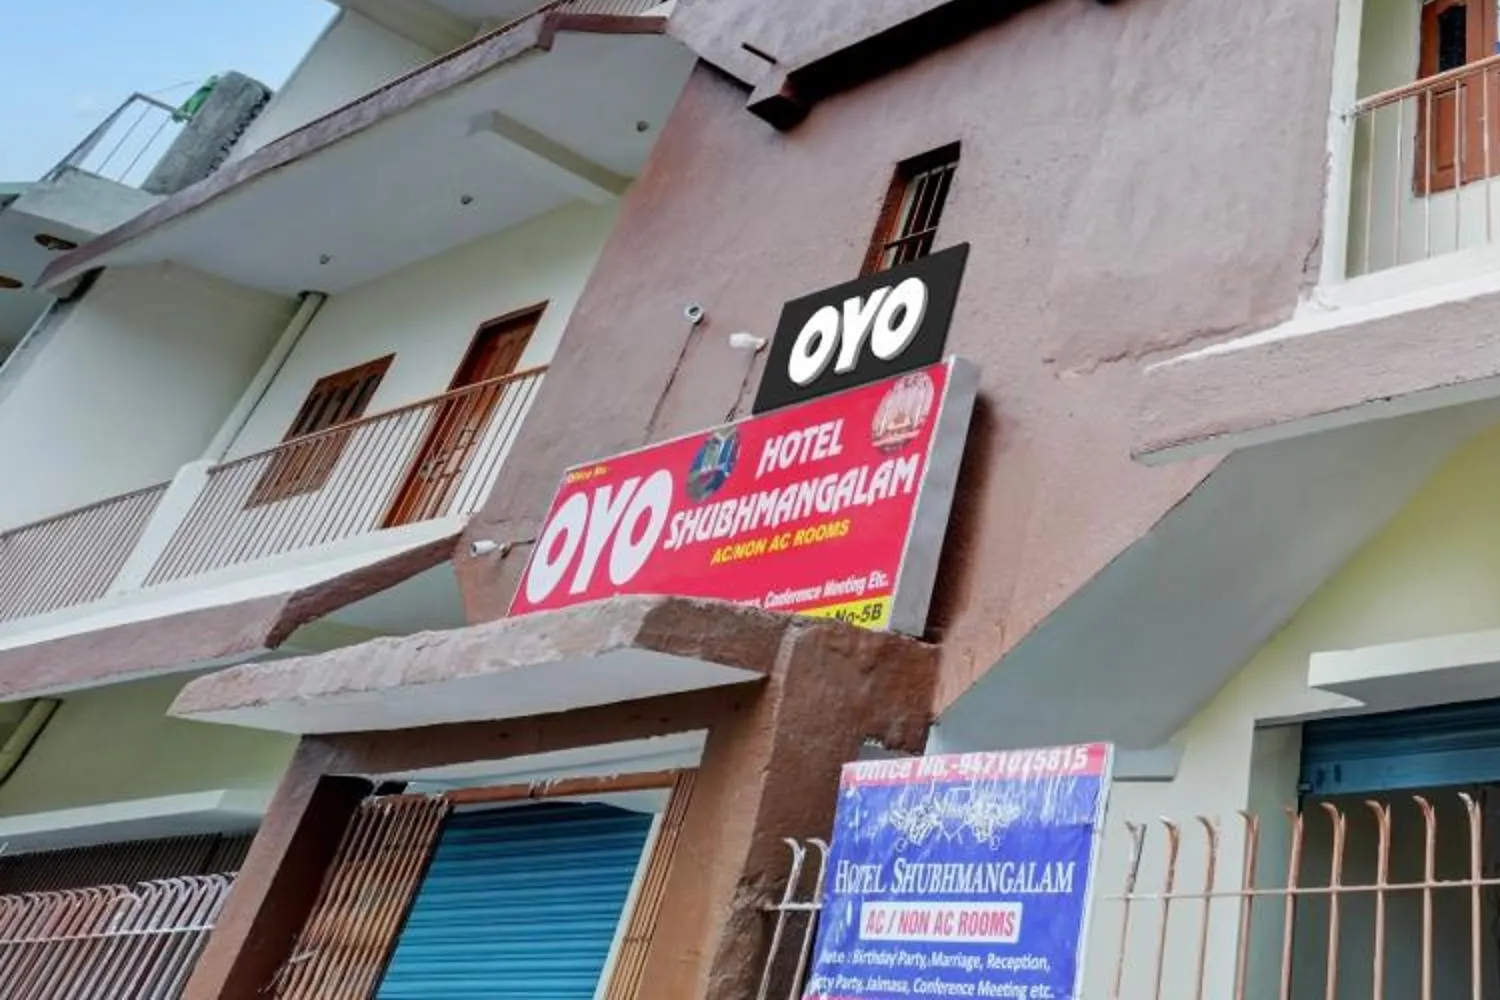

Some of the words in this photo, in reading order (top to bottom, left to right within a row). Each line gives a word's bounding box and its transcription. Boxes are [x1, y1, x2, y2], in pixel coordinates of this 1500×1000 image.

[788, 277, 928, 386] OYO
[755, 418, 844, 479] HOTEL
[663, 453, 921, 551] SHUBHMANGALAM
[526, 469, 673, 604] OYO
[768, 532, 792, 553] AC
[792, 518, 852, 546] ROOMS
[764, 585, 822, 608] Conference
[823, 576, 866, 597] Meeting
[855, 759, 911, 780] Office
[834, 860, 887, 894] HOTEL
[890, 858, 1075, 894] SHUBHMANGALAM
[866, 909, 886, 934] AC
[899, 909, 931, 935] NON
[934, 910, 955, 936] AC
[957, 910, 1016, 937] ROOMS
[852, 950, 898, 969] Birthday
[986, 952, 1050, 974] Reception,
[913, 977, 976, 996] Conference
[977, 980, 1028, 1000] Meeting
